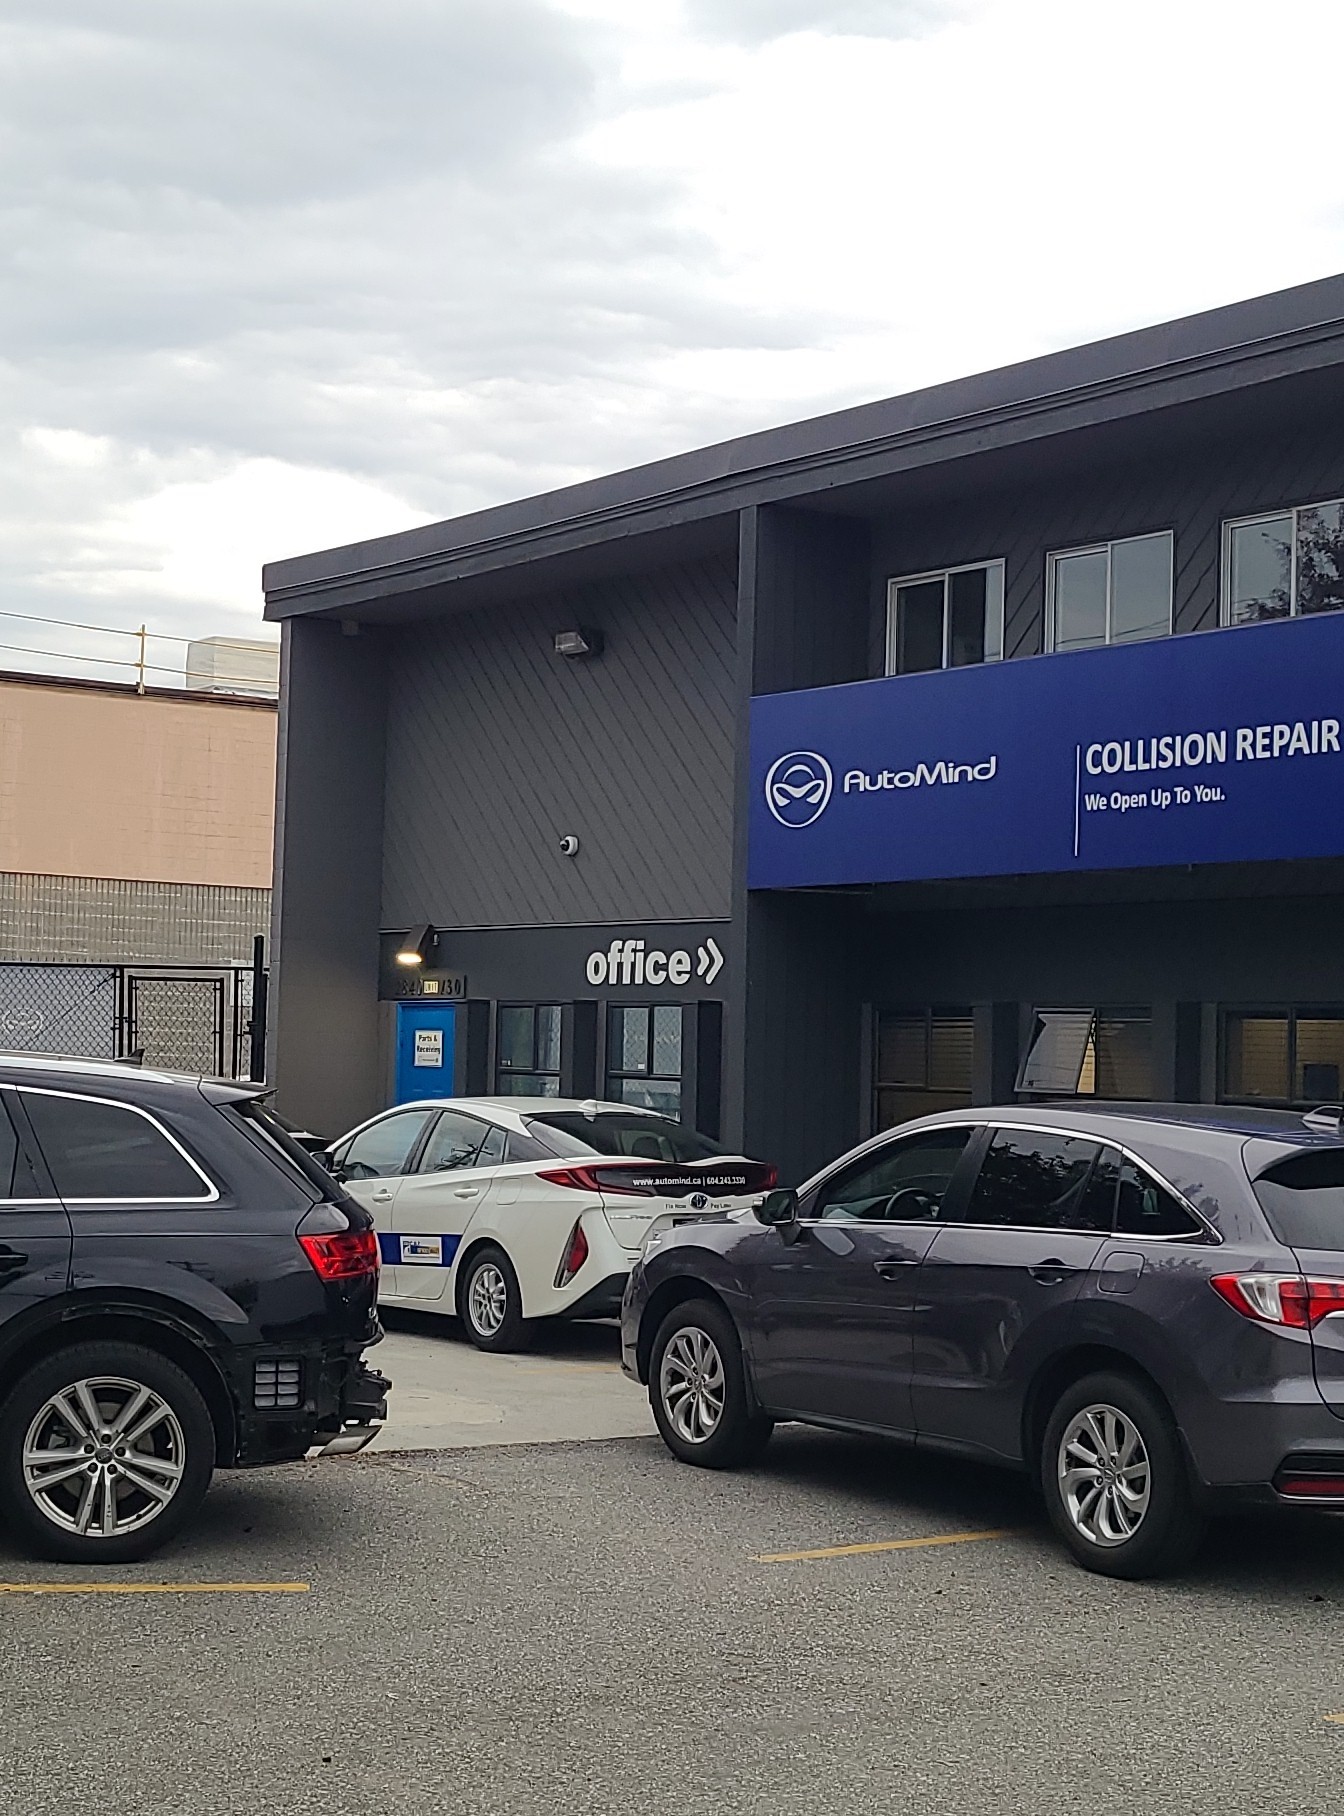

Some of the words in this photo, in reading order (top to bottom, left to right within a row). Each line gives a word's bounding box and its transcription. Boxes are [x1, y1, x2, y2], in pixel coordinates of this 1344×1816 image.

[1085, 730, 1227, 775] COLLISION
[1235, 719, 1341, 761] REPAIR
[843, 755, 997, 793] AutoMind
[1084, 793, 1108, 811] We
[1110, 791, 1147, 813] Open
[1150, 788, 1171, 810] Up
[1173, 786, 1191, 804] To
[1193, 784, 1226, 803] You.
[586, 939, 691, 985] office
[632, 1176, 701, 1186] www.automind.ca
